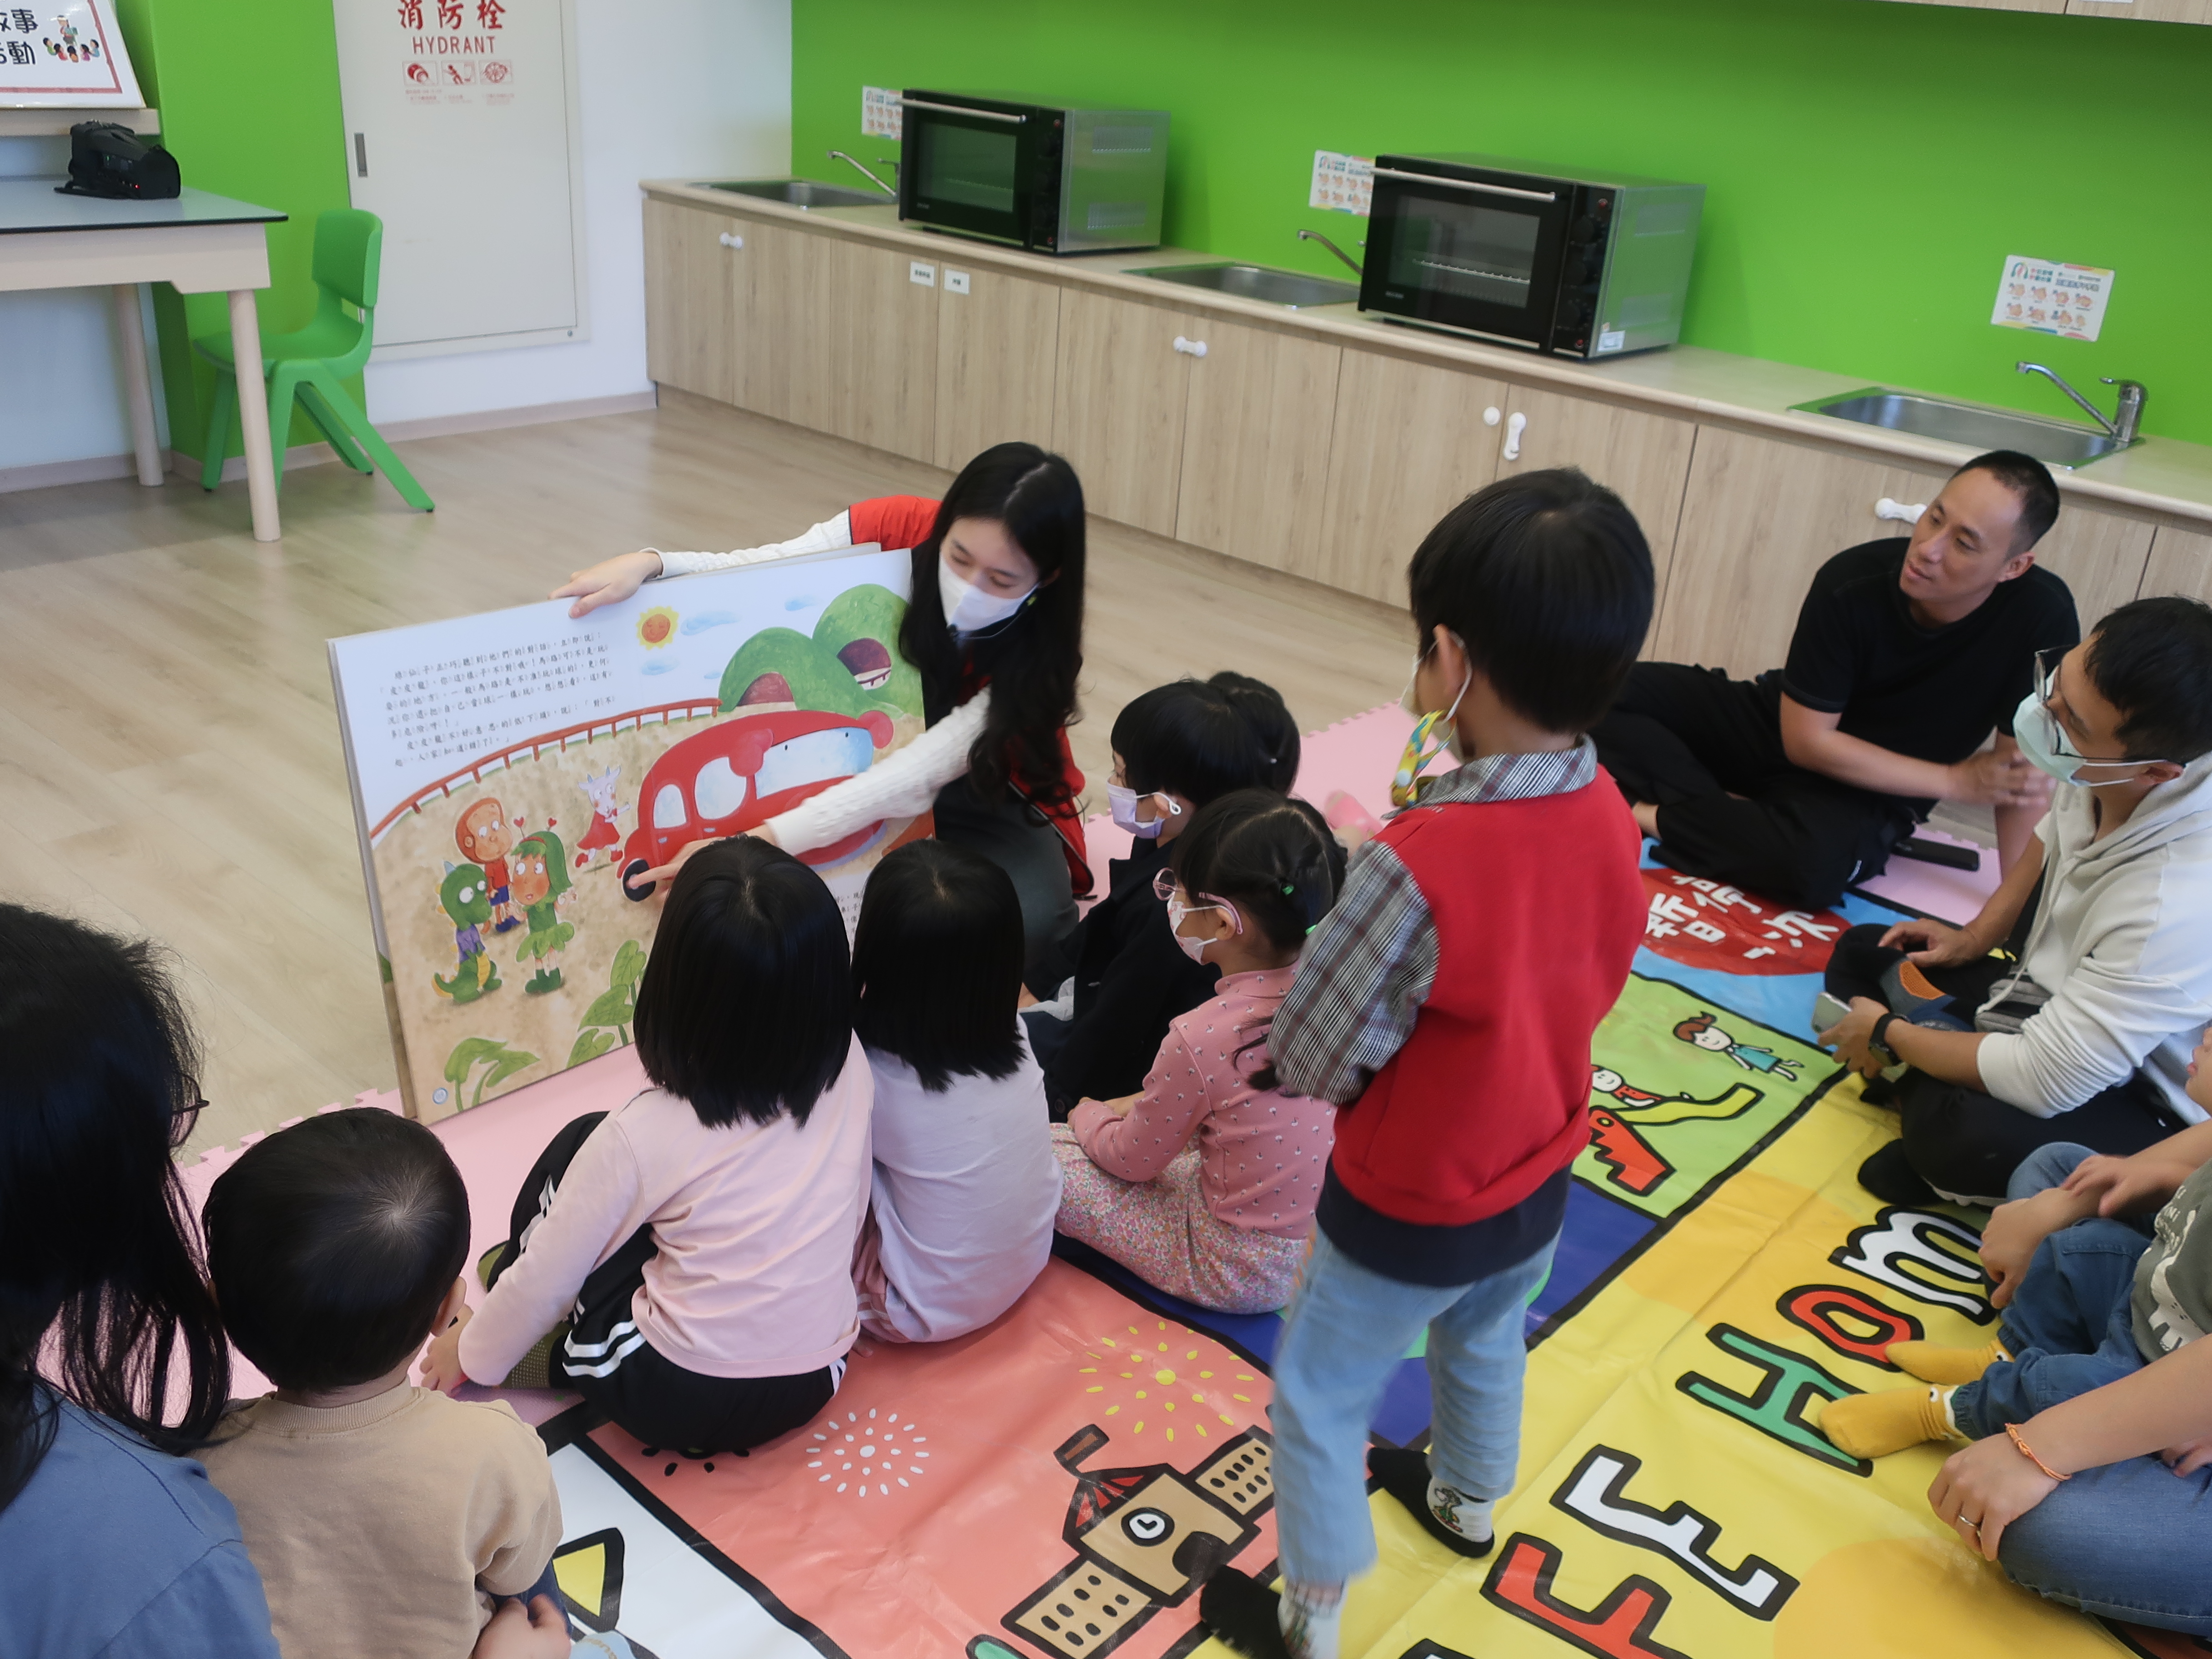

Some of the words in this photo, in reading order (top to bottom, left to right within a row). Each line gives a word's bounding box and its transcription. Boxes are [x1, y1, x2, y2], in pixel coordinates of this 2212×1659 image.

[397, 0, 506, 30] 消防栓
[0, 41, 35, 65] 動
[412, 36, 496, 55] HYDRANT
